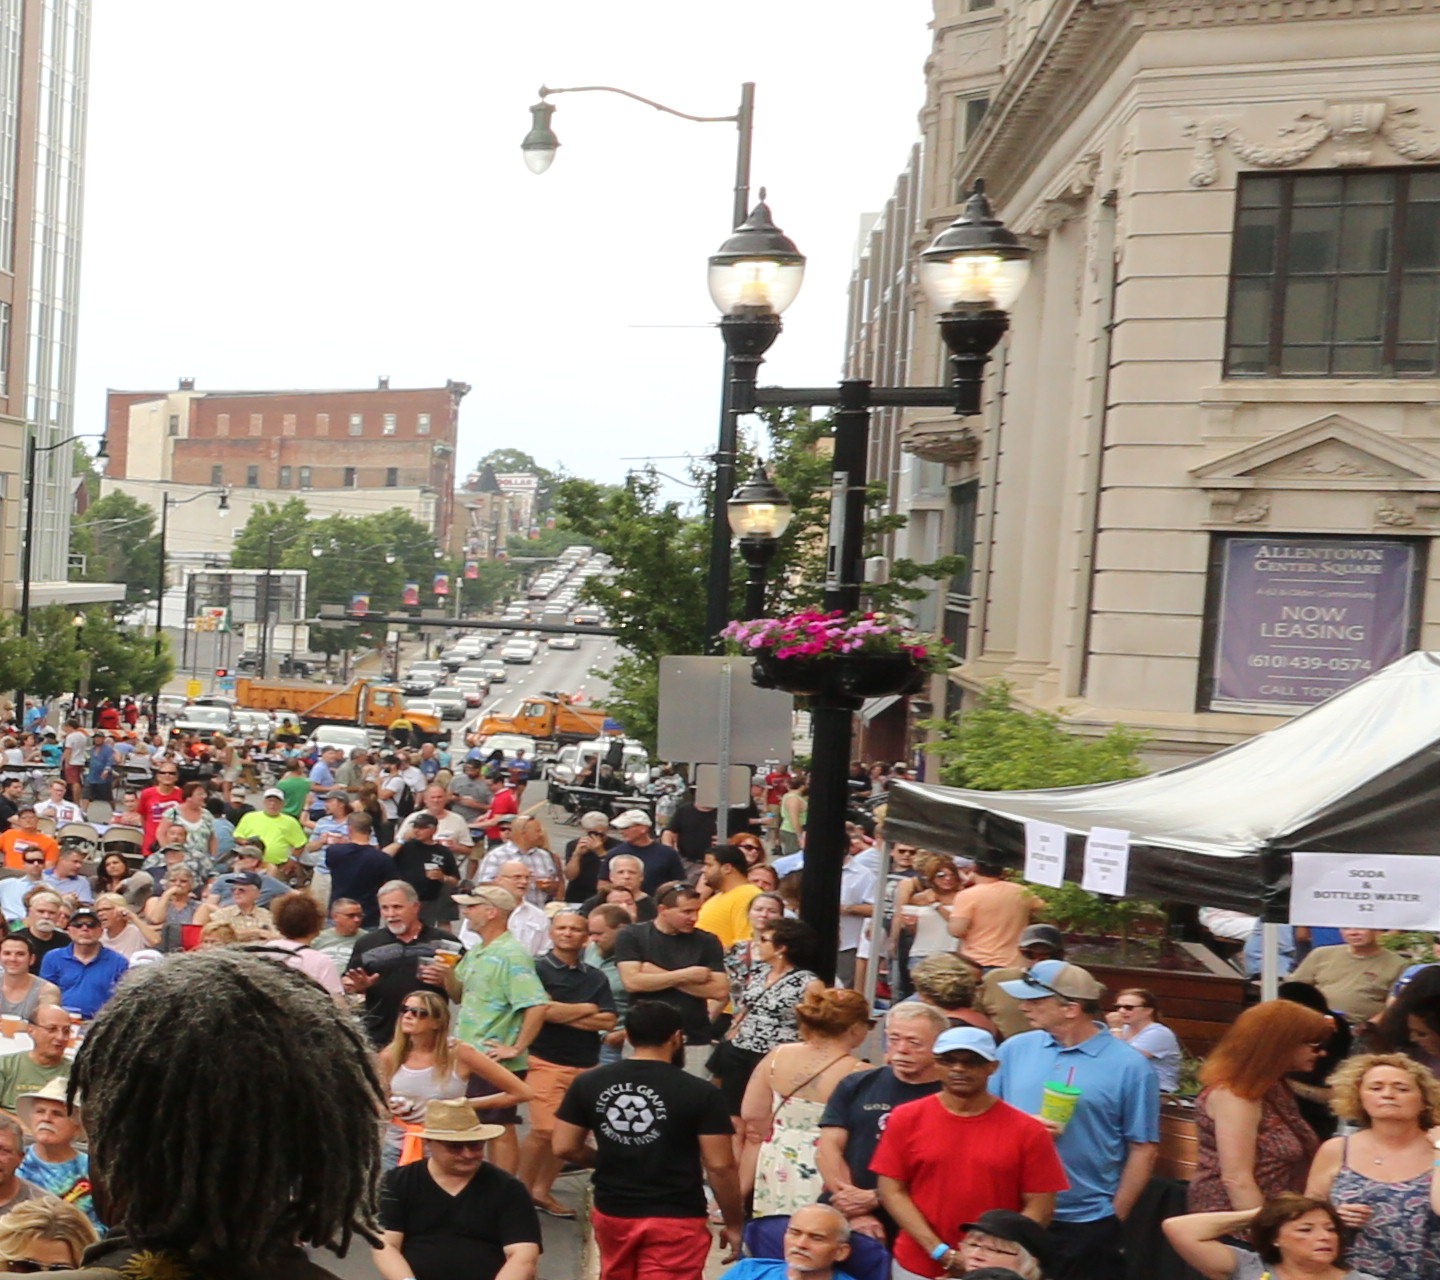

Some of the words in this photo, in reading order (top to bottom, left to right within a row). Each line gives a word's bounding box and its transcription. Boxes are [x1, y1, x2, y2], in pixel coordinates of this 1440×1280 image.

[1255, 545, 1383, 561] ALLENTOWN
[1254, 560, 1316, 576] CENTER
[1320, 562, 1383, 577] SQUARE
[1282, 606, 1349, 622] NOW
[1260, 623, 1365, 642] LEASING
[1258, 684, 1295, 697] CALL
[1348, 868, 1386, 880] SODA
[1313, 890, 1370, 902] BOTTLED
[1374, 892, 1421, 903] WATER
[596, 1082, 633, 1114] RECYCLE
[636, 1083, 668, 1121] GRAPES
[599, 1121, 631, 1146] DRINK
[632, 1126, 662, 1146] WINE
